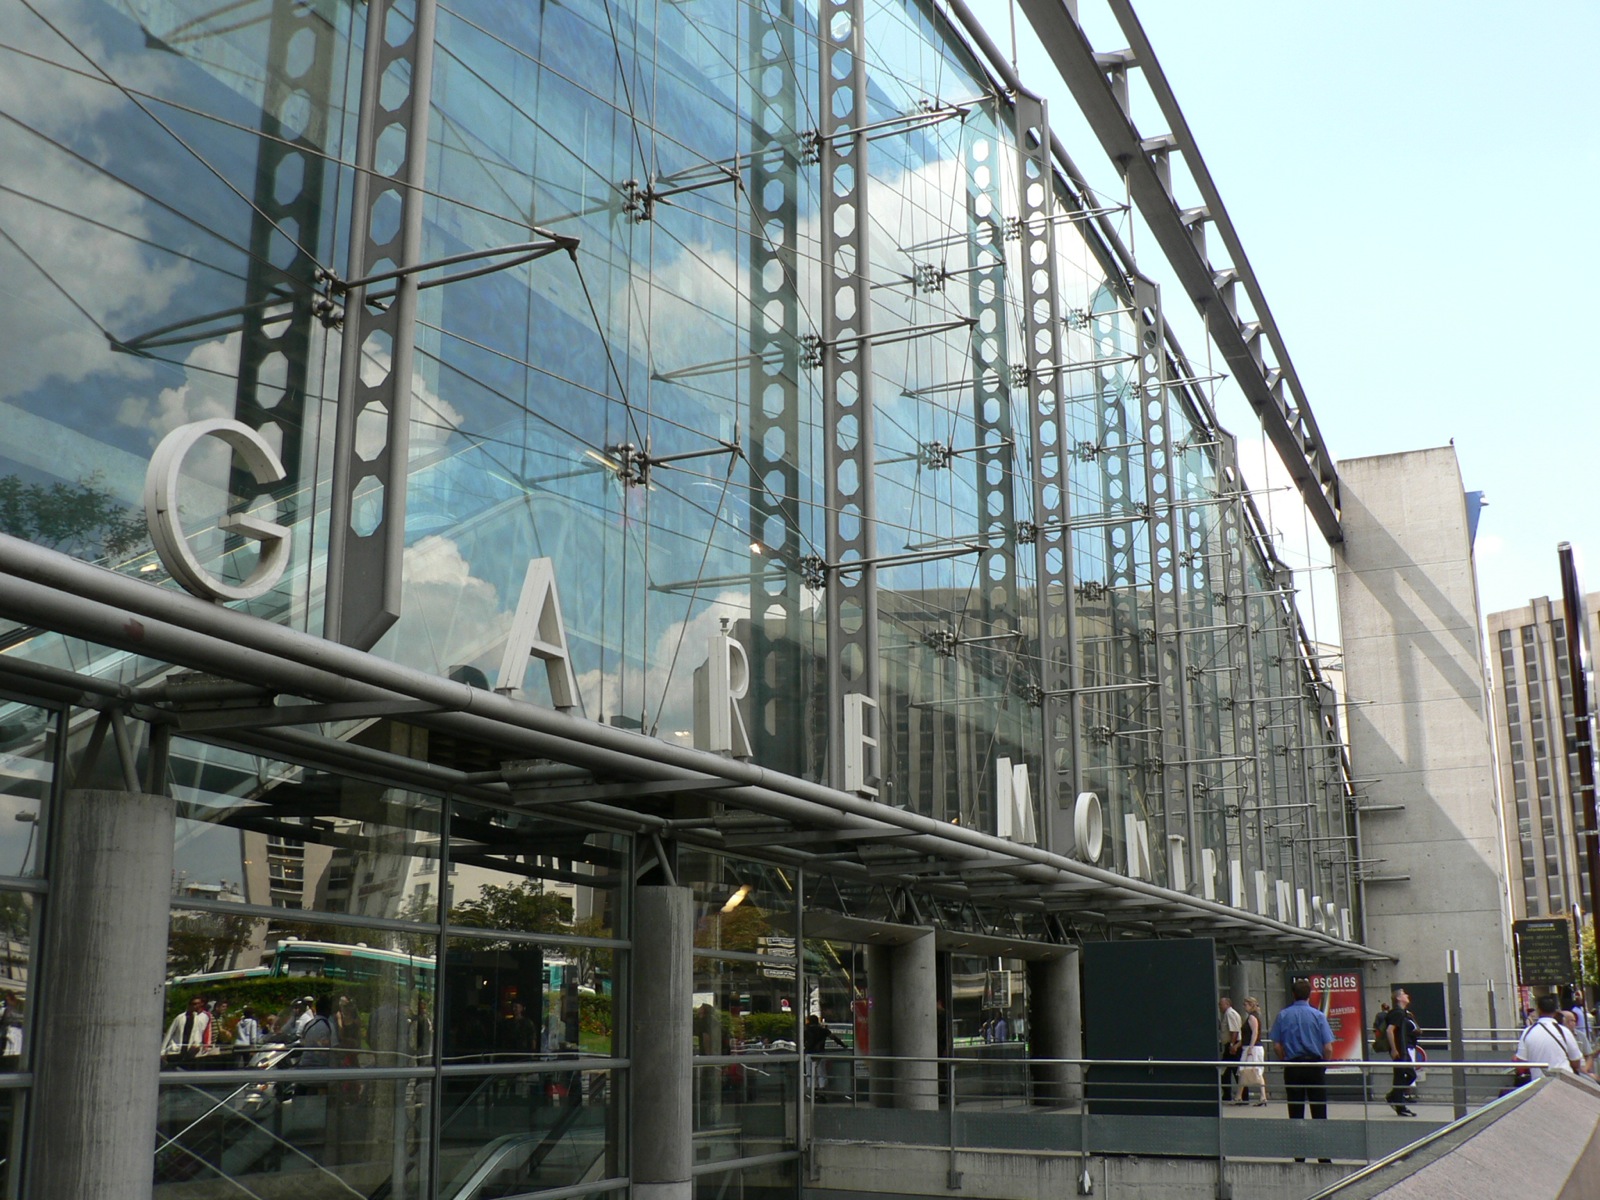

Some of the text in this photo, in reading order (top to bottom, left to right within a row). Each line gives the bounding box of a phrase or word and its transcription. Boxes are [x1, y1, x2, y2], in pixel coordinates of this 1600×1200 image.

[144, 418, 1354, 942] GARE MONTPARNASSE
[1313, 976, 1356, 988] escales
